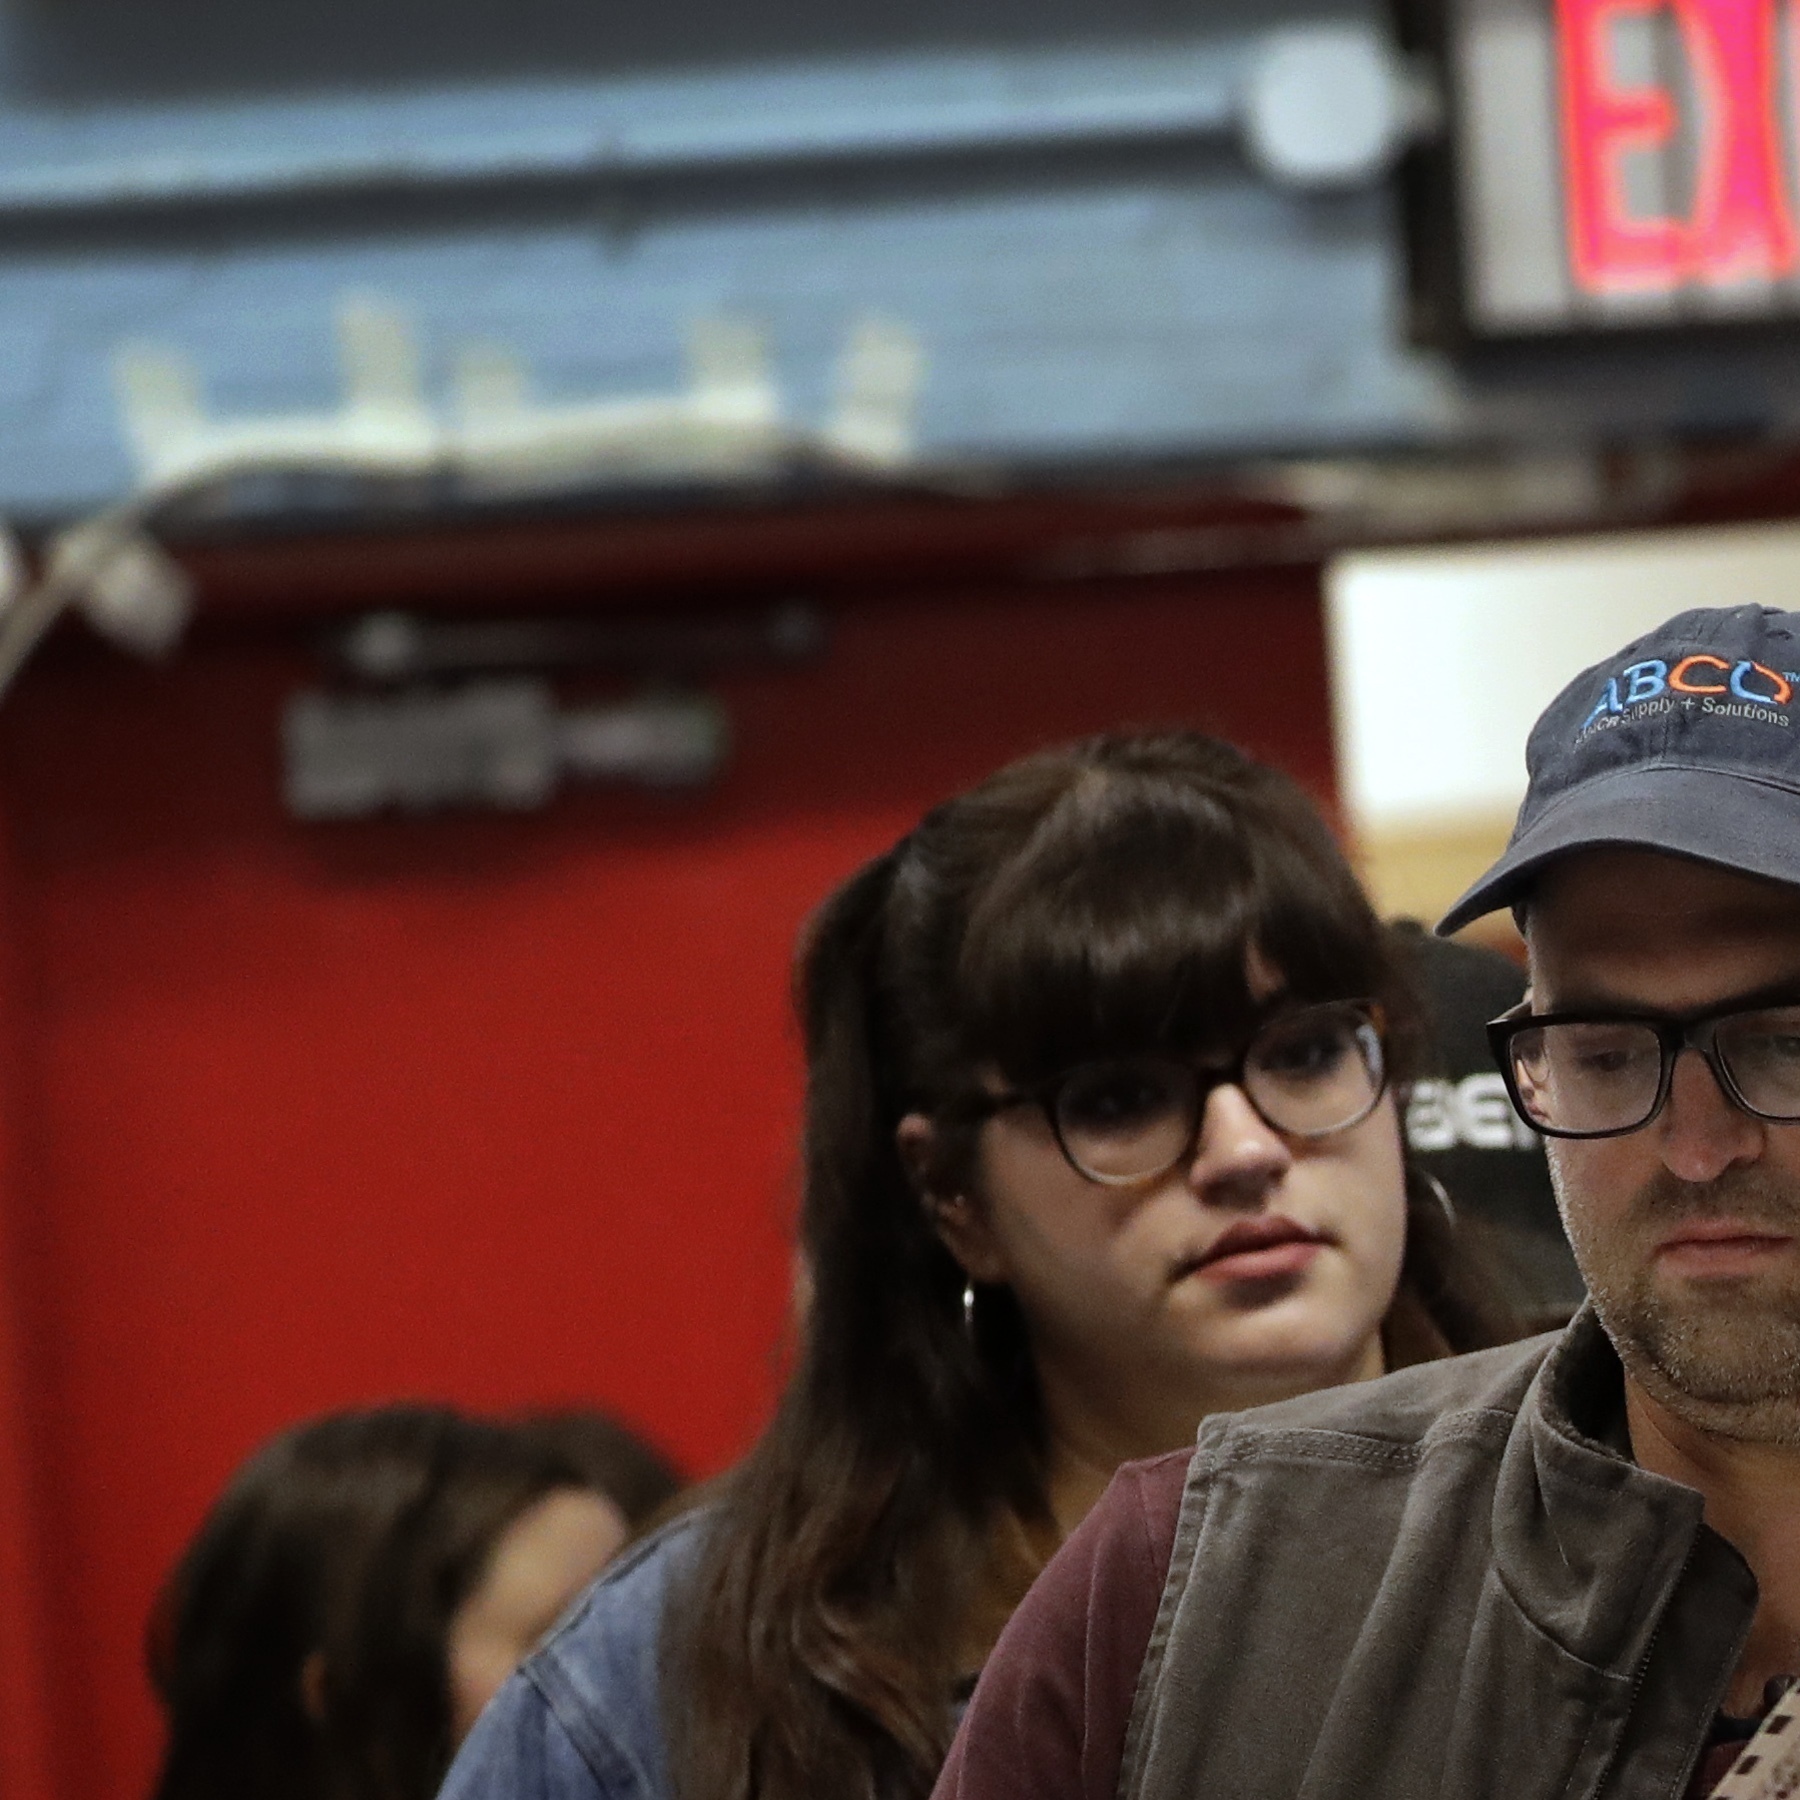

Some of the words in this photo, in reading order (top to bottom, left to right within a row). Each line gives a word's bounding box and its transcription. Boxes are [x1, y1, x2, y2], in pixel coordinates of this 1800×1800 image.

[1581, 654, 1793, 729] ABCO
[1622, 697, 1675, 724] Supply
[1702, 696, 1790, 728] Solutions
